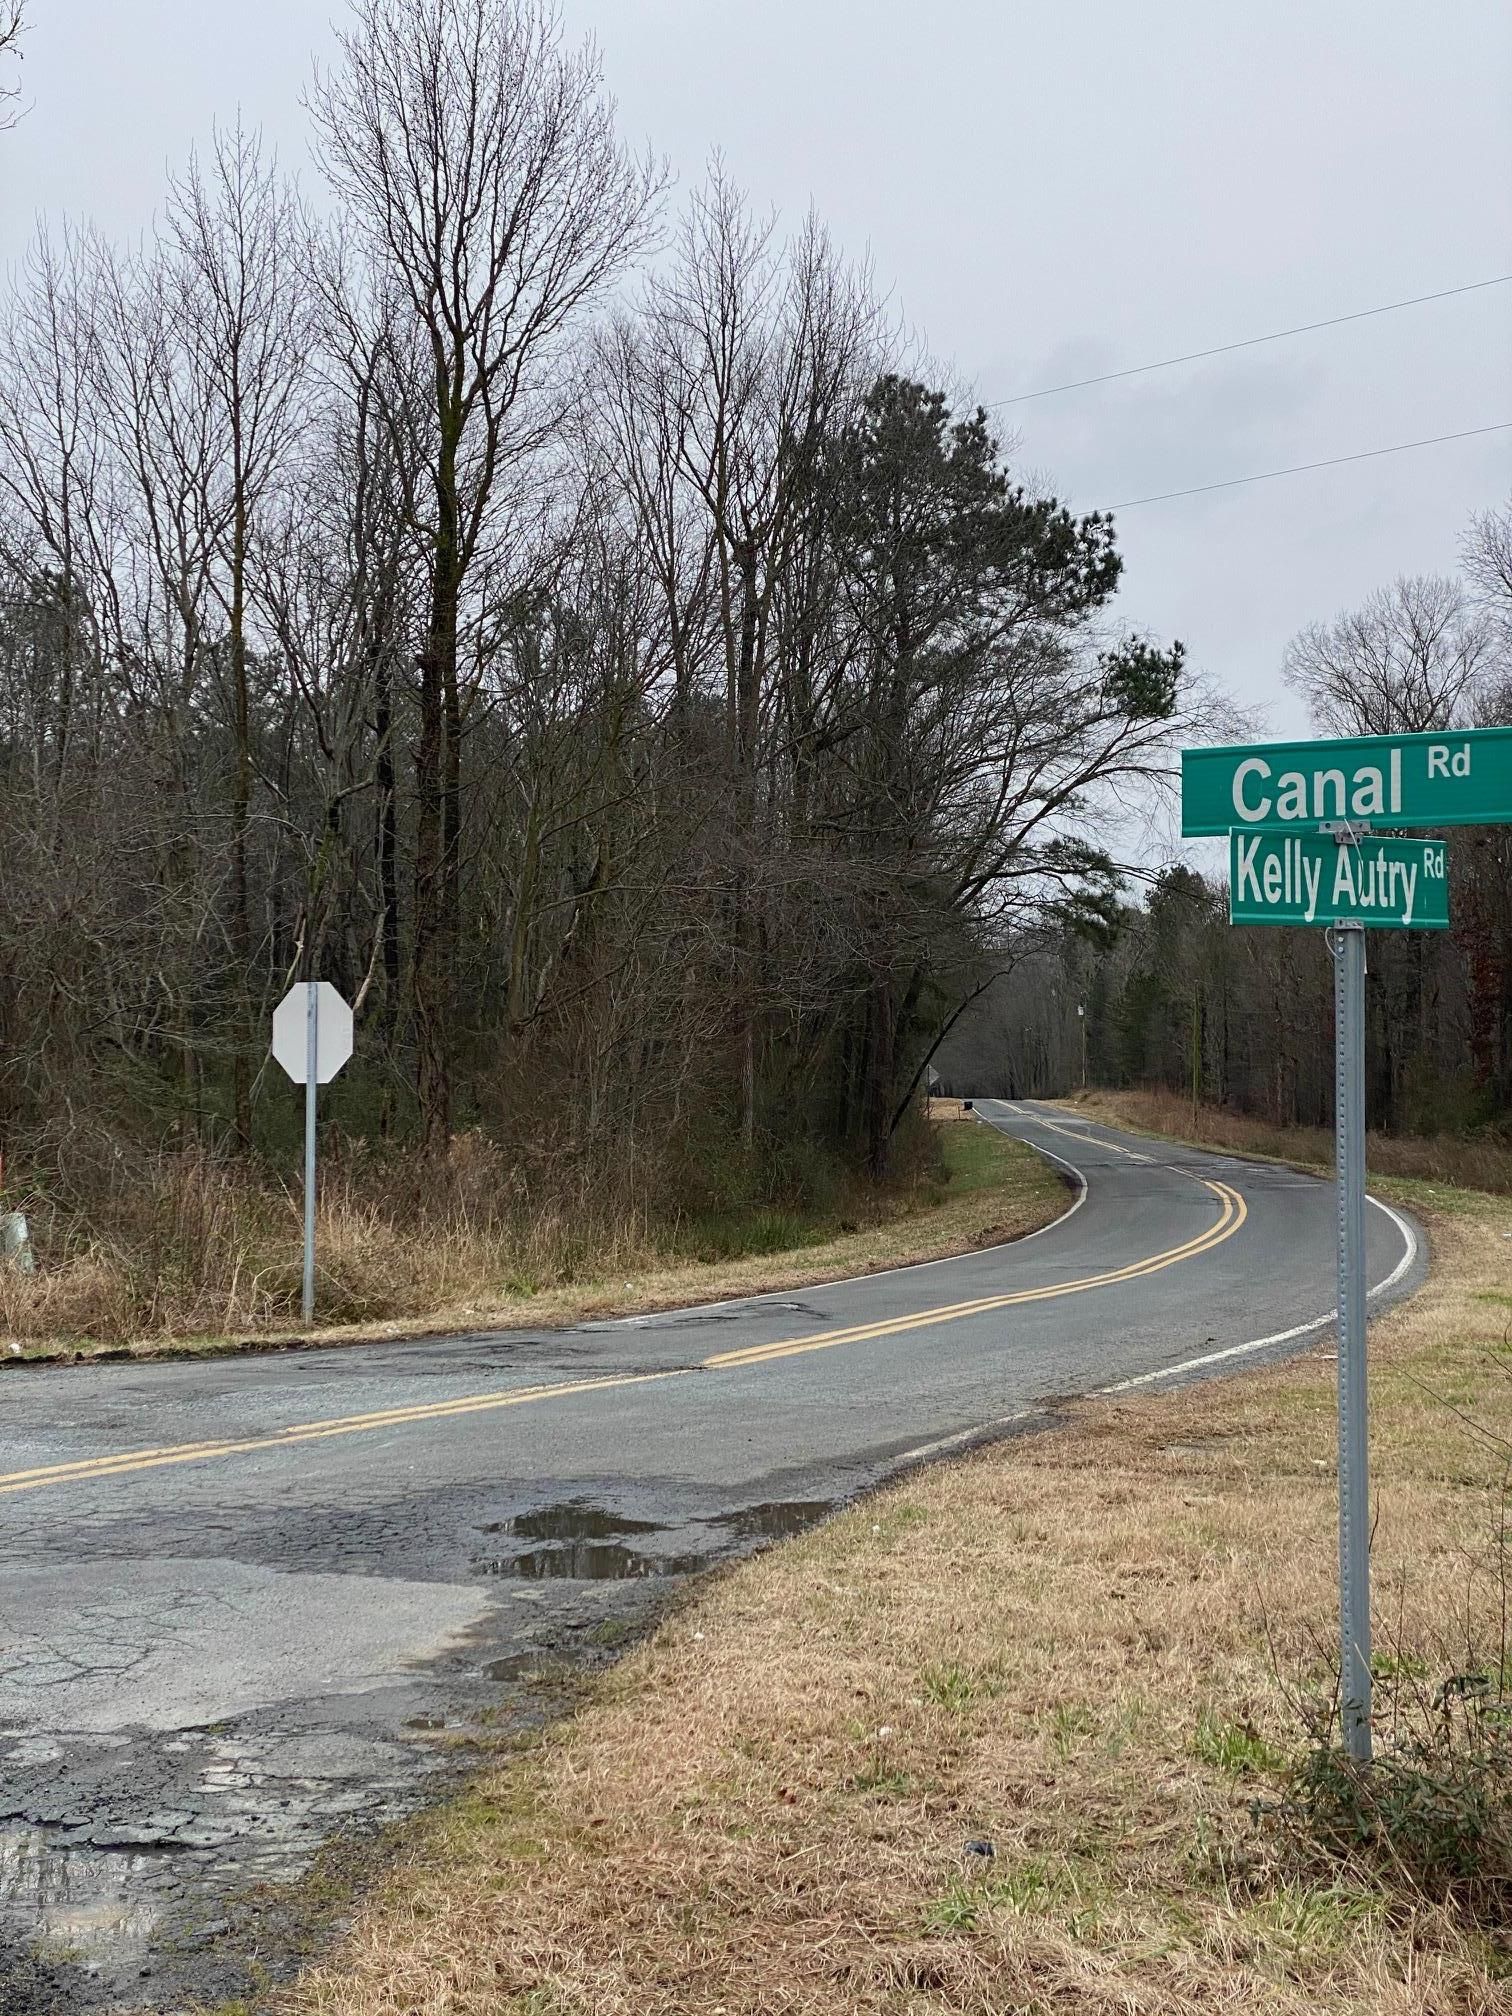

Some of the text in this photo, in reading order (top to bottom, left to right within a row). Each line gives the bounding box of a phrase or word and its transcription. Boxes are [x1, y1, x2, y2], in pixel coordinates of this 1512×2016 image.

[1232, 743, 1471, 822] Canal Rd
[1237, 835, 1444, 925] Kelly Autry Rd
